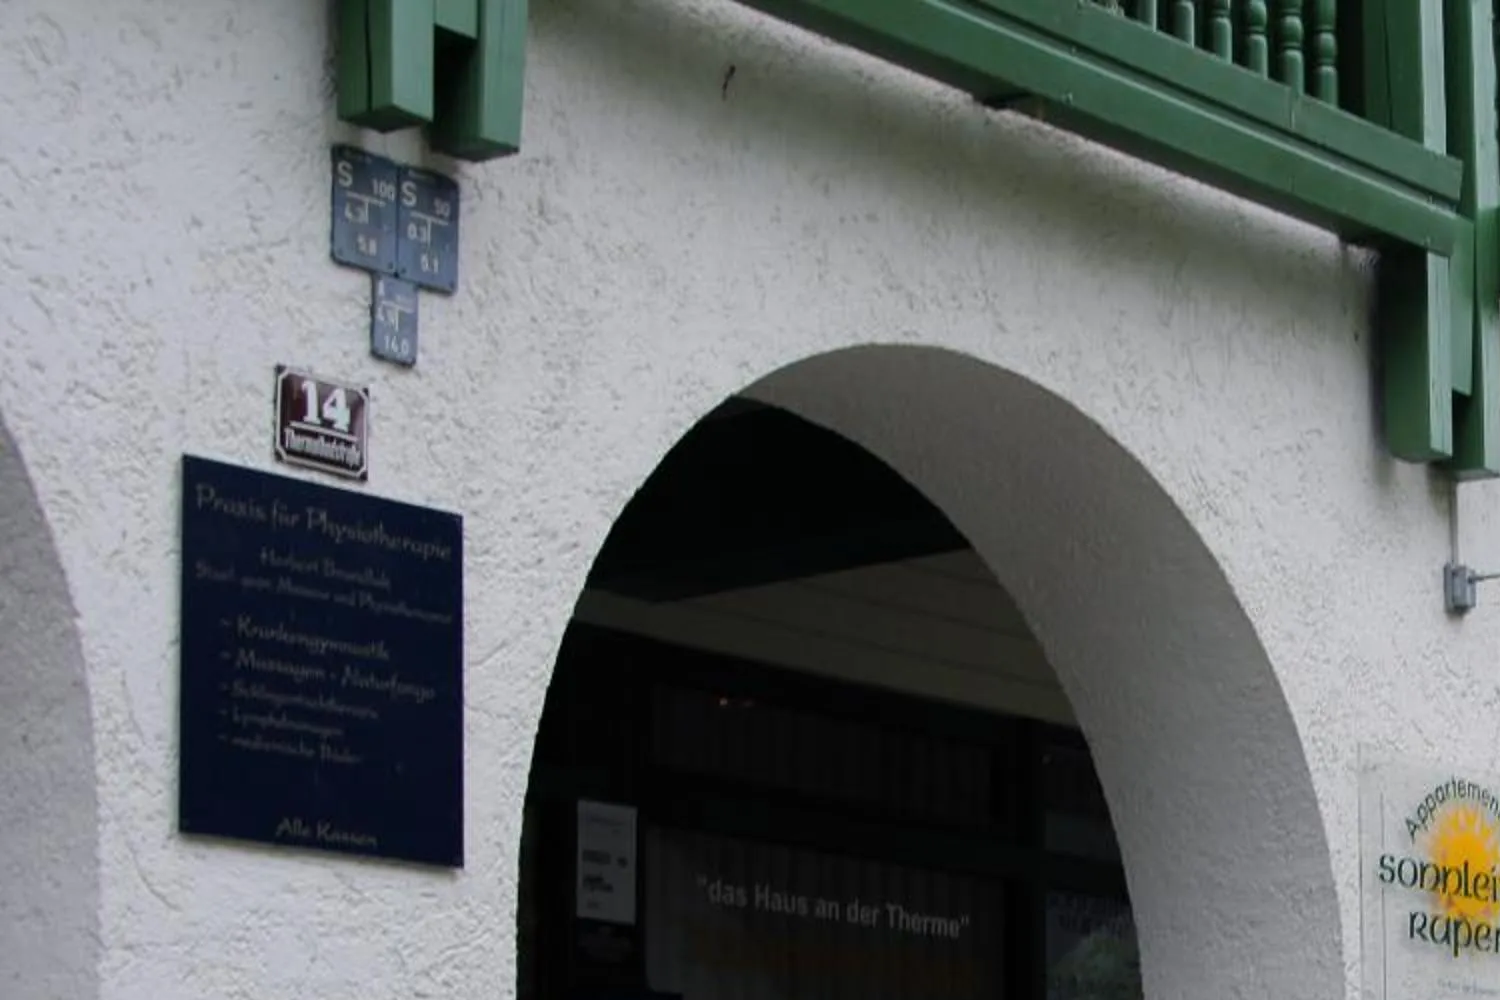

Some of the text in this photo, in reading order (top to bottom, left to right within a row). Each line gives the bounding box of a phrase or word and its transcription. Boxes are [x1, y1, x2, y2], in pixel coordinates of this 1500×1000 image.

[337, 160, 396, 202] S 100
[401, 181, 417, 207] S
[301, 380, 351, 433] 14
[195, 482, 452, 561] Praxis für Physiotherapie
[236, 614, 390, 661] Krankengymnastik
[235, 647, 436, 704] Massagen Naturfango
[275, 816, 379, 850] Alle Kassen
[754, 882, 809, 917] Haus
[814, 897, 840, 921] an
[846, 898, 881, 927] der
